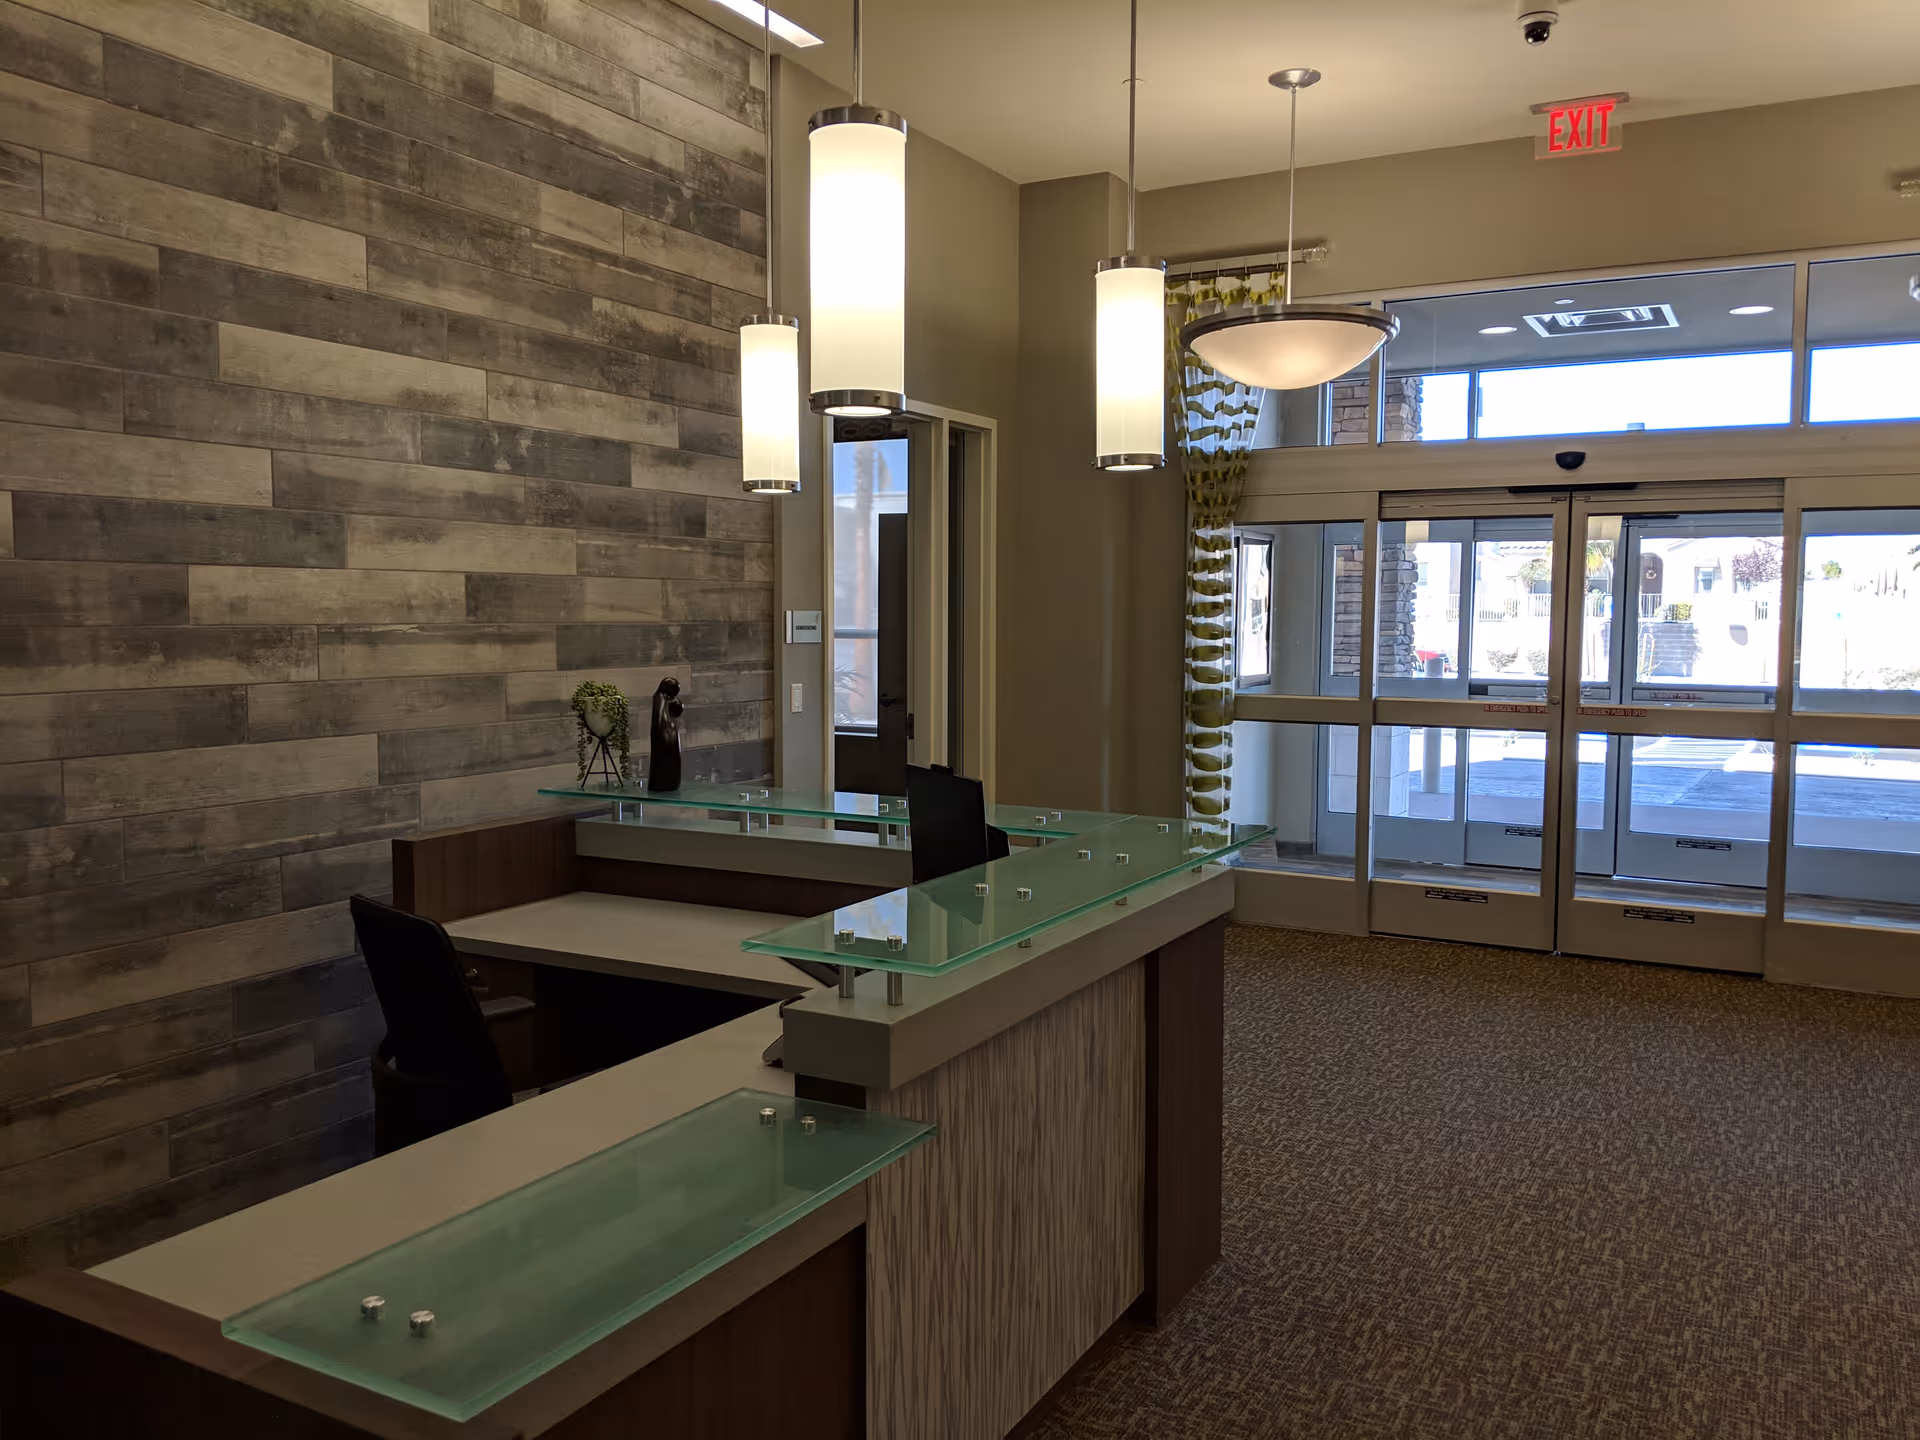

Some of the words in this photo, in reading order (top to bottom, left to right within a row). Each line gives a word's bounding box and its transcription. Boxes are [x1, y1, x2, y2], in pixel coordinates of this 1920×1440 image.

[1549, 102, 1615, 152] EXIT
[1490, 704, 1515, 712] EMERGENCY
[1516, 705, 1529, 713] PUSH
[1611, 708, 1625, 716] PUSH
[1632, 709, 1646, 717] OPEN
